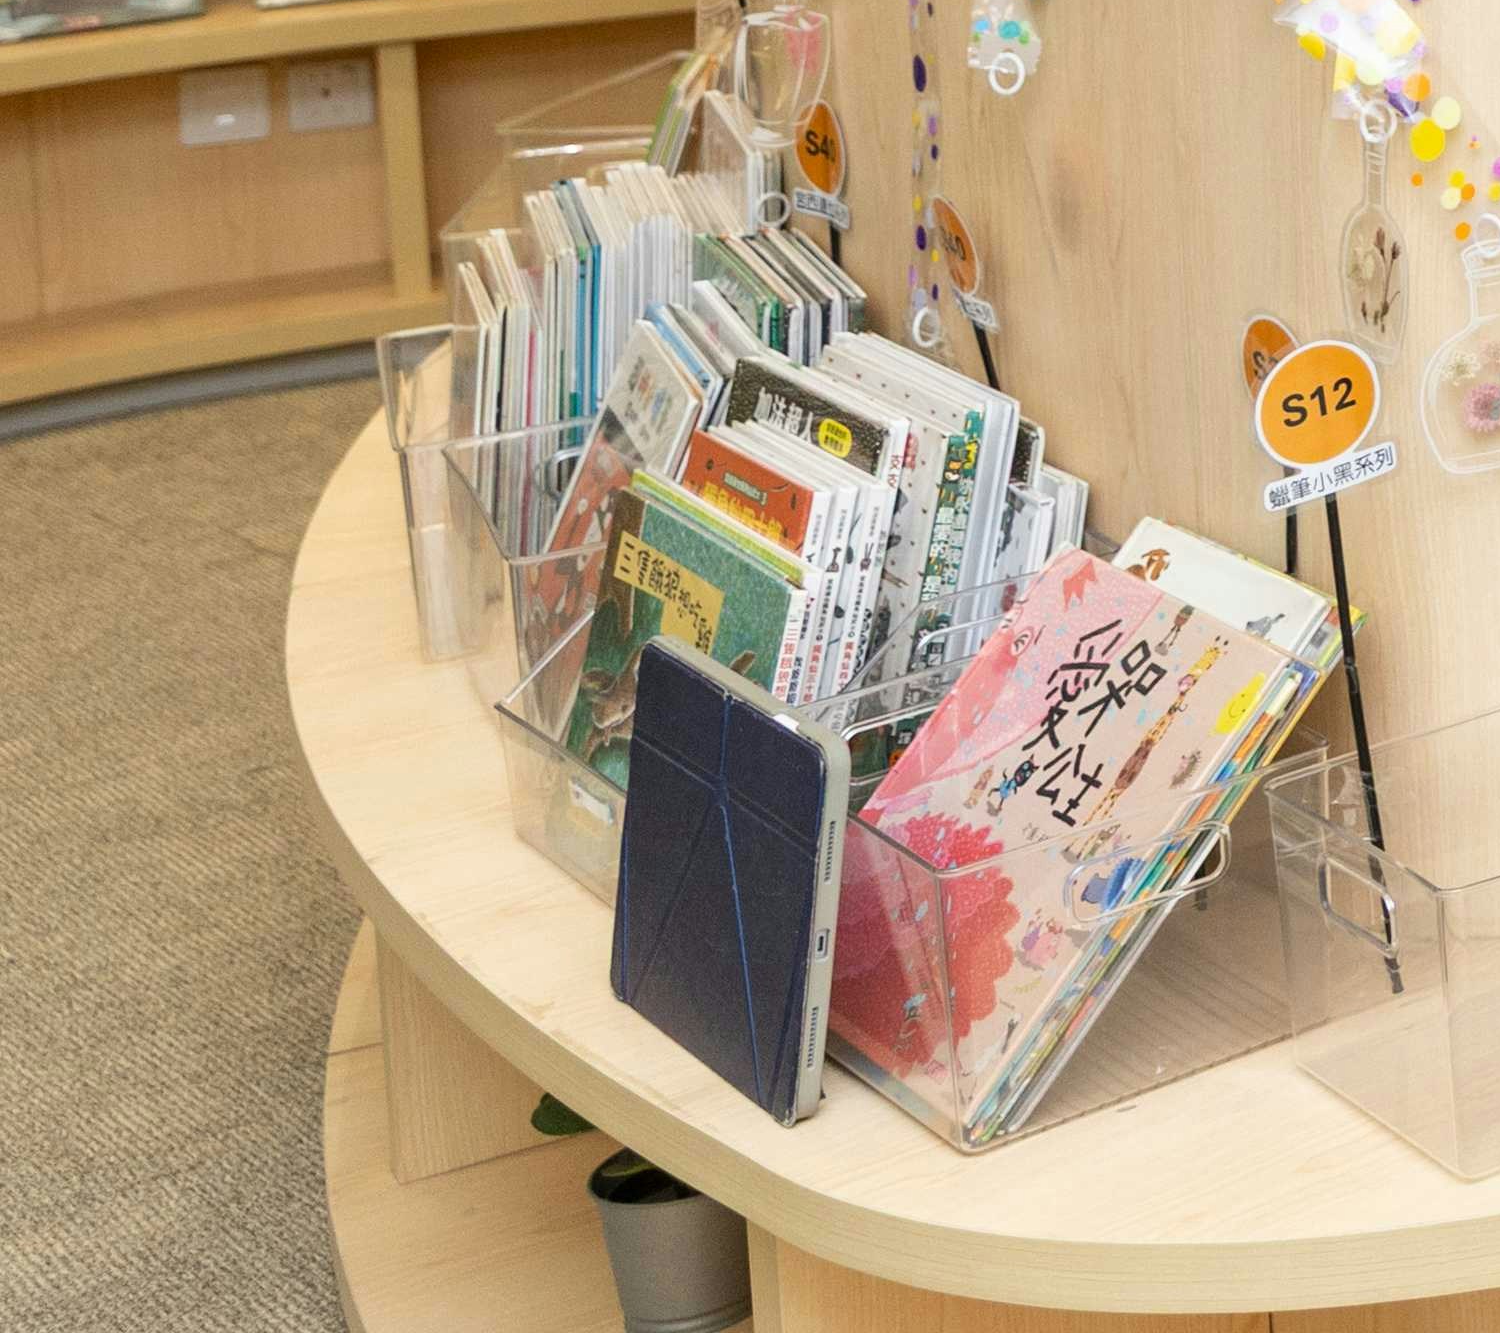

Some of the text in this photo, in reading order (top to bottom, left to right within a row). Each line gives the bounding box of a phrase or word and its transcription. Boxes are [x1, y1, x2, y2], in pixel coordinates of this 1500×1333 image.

[1281, 375, 1358, 428] S12
[1268, 445, 1395, 510] 蠟筆小黑系列
